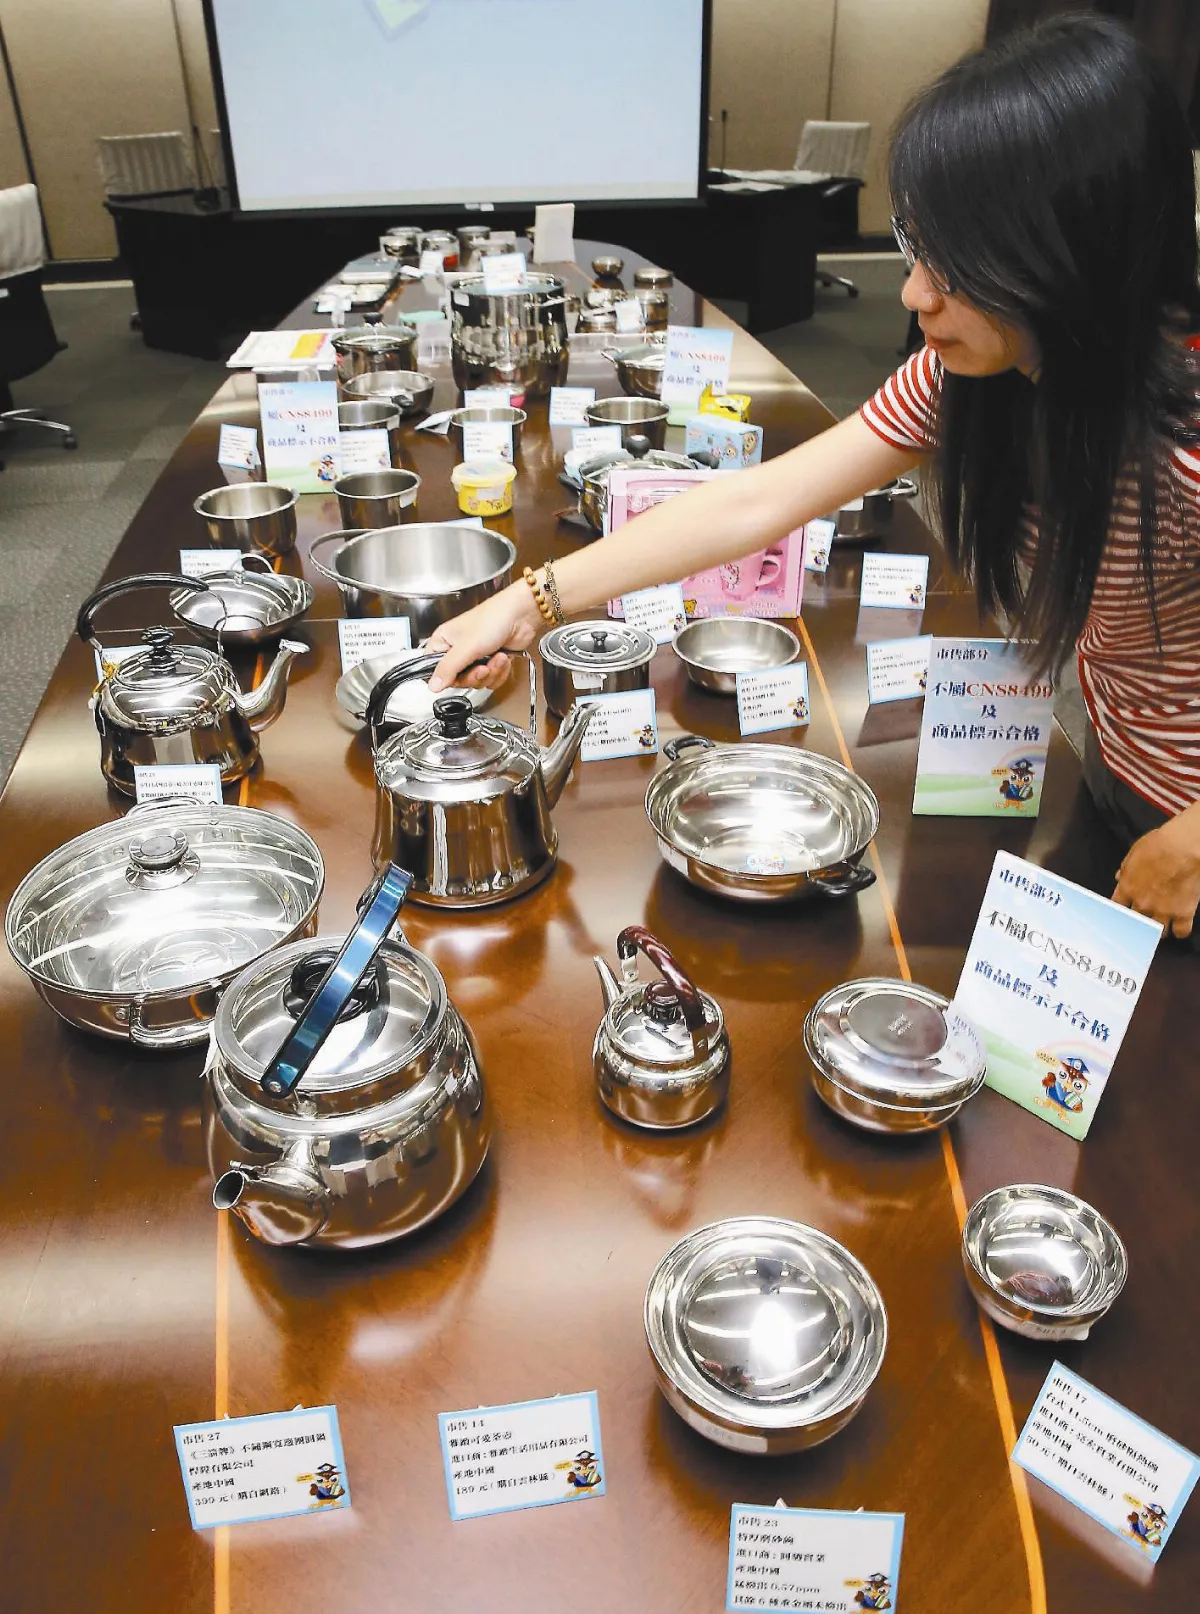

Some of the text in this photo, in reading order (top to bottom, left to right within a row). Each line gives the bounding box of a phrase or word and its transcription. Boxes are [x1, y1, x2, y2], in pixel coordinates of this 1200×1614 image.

[980, 704, 998, 720] 及
[932, 723, 1040, 742] 商品標示合格
[999, 868, 1064, 908] 市售部分
[1036, 963, 1059, 989] 及
[975, 958, 1112, 1043] 商品標示不合格
